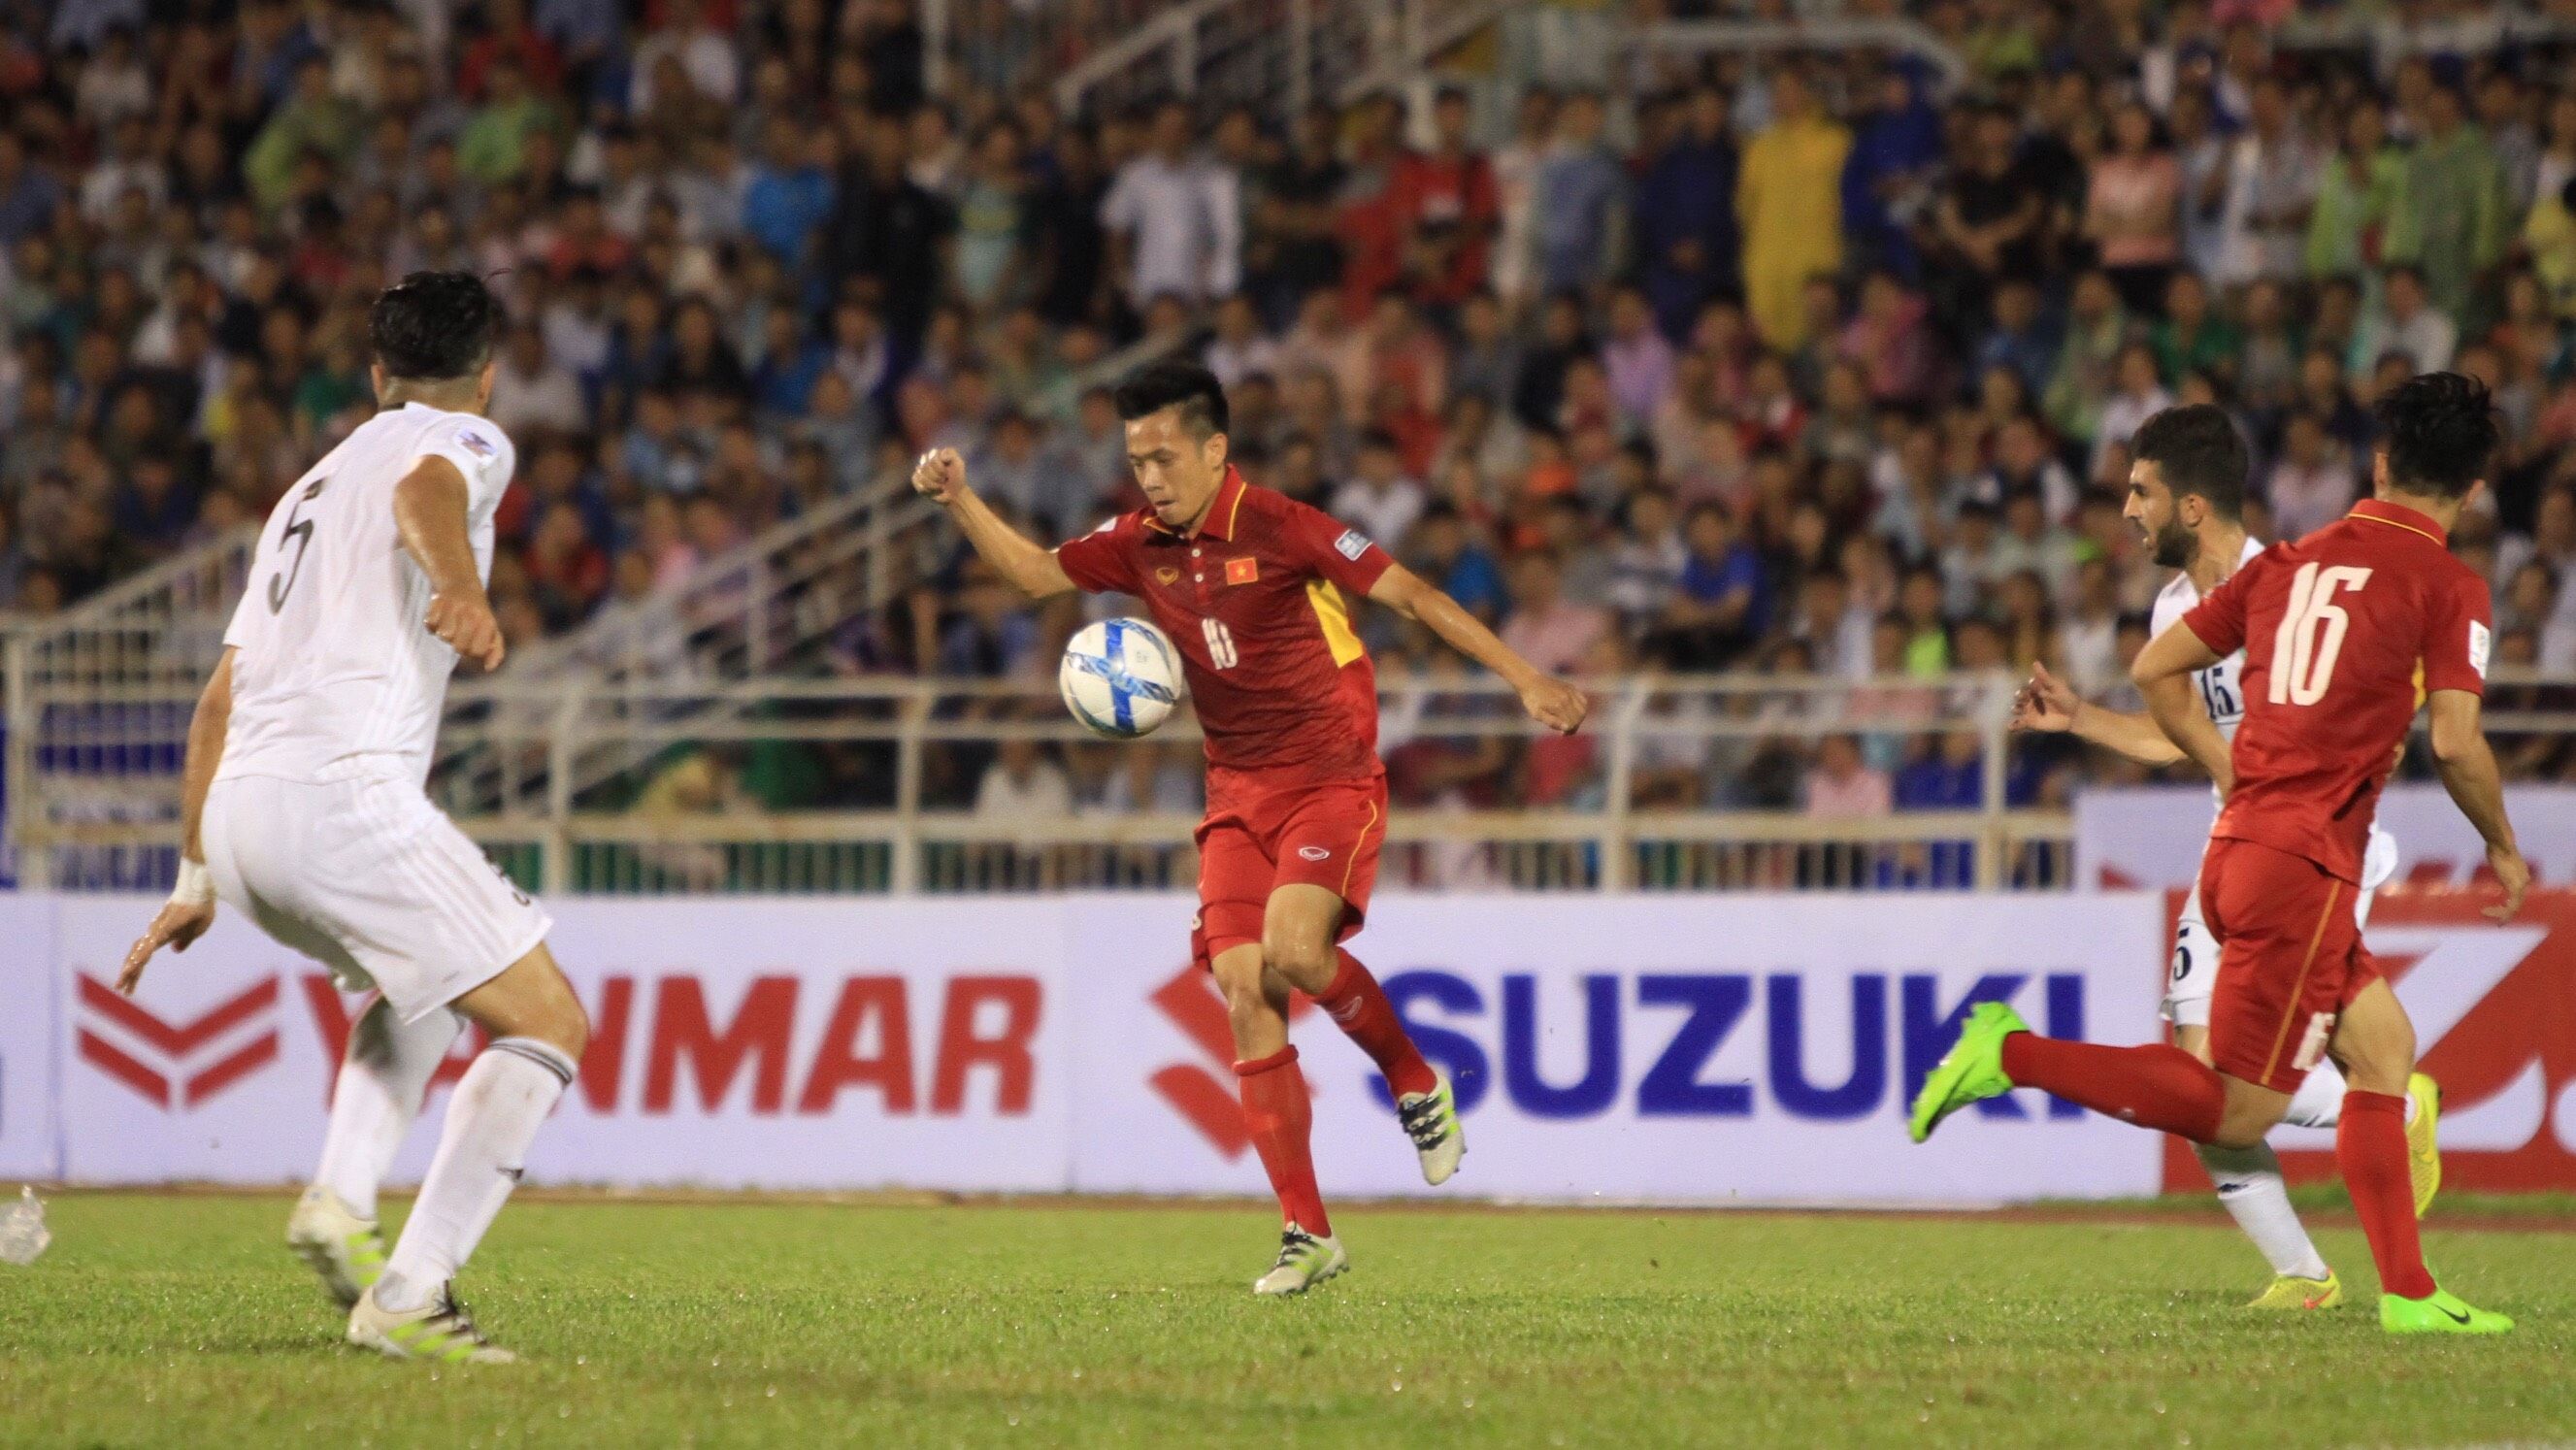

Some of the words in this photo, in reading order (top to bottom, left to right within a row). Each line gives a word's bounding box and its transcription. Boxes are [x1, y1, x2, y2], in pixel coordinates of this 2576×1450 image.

[268, 478, 332, 617] 5
[1202, 617, 1238, 671] 10
[2199, 666, 2235, 720] 15
[2267, 561, 2374, 708] 16
[1367, 970, 2087, 1122] SUZUKI
